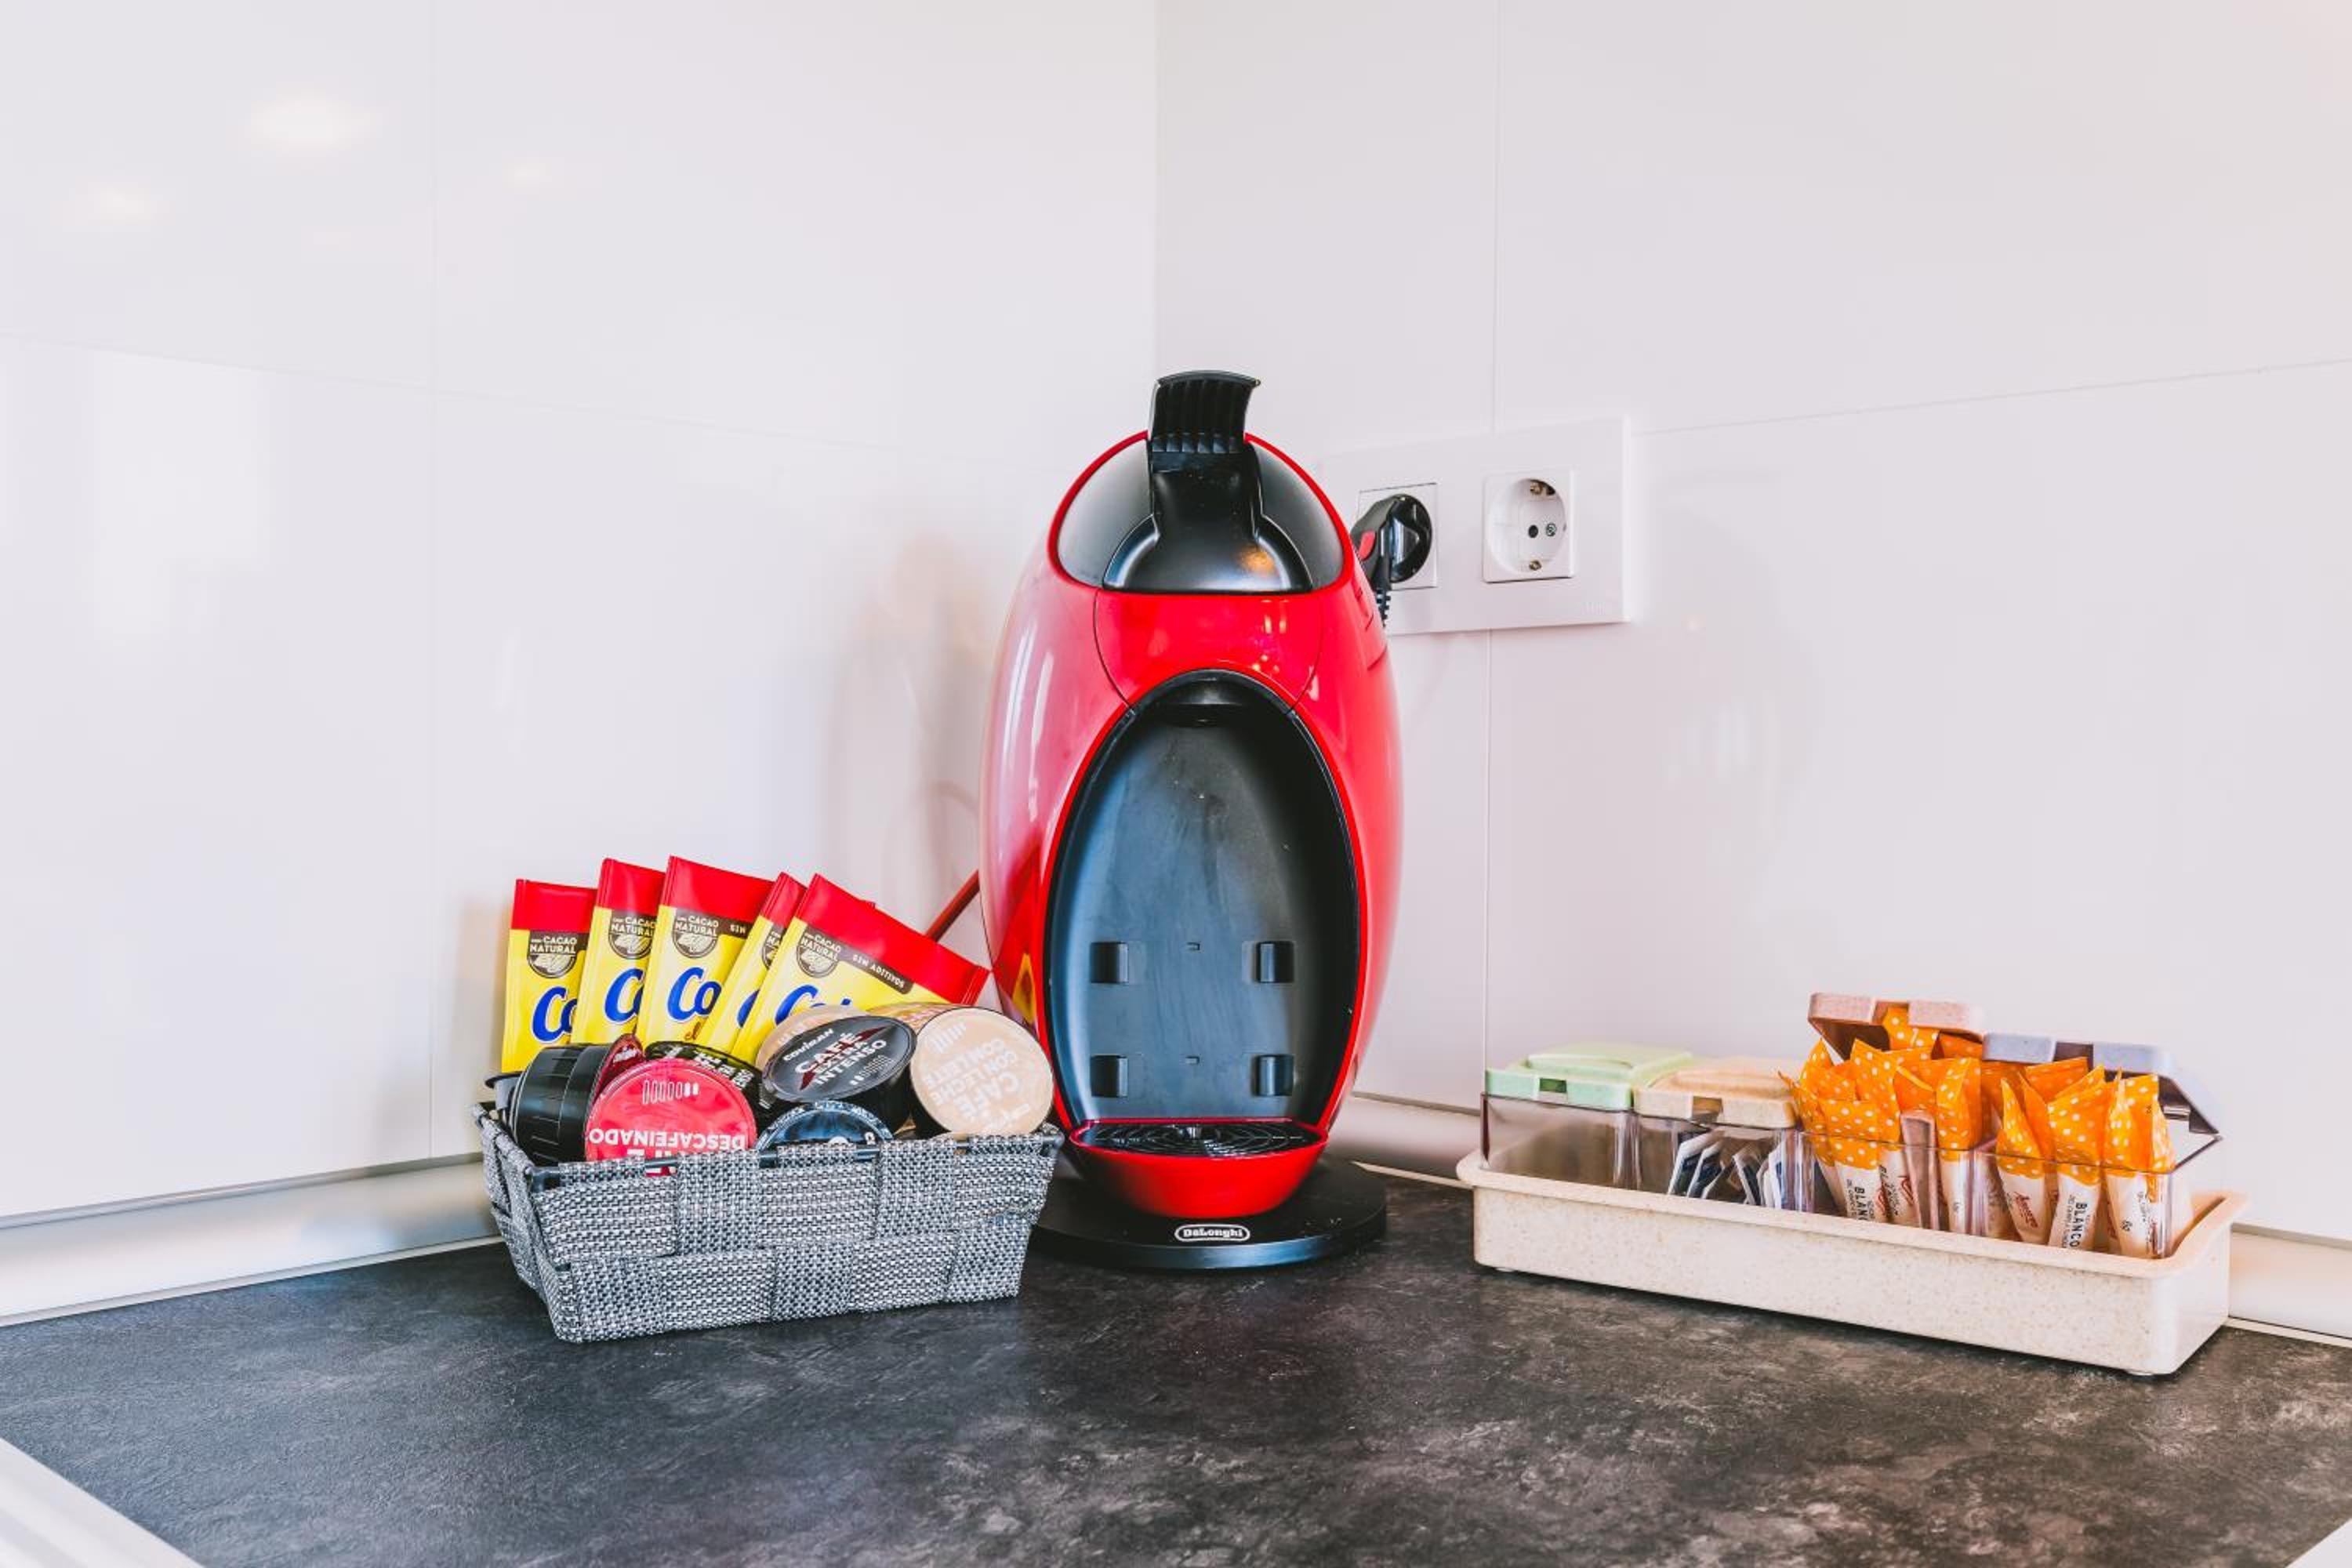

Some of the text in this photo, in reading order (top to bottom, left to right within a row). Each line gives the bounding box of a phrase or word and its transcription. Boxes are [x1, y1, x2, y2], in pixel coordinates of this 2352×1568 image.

[674, 921, 718, 937] NATURAL
[688, 916, 720, 927] CACAO
[730, 924, 746, 934] SIN
[529, 944, 576, 955] NATURAL
[543, 935, 578, 945] CACAO
[800, 937, 839, 961] NATURAL
[814, 933, 842, 953] CACAO
[852, 953, 906, 989] SIN ADITIVOS
[794, 1031, 862, 1074] CAFÉ
[814, 1039, 887, 1085] INTENSO
[589, 1127, 746, 1150] DESCAFEINADO
[2069, 1202, 2088, 1247] BLANCO
